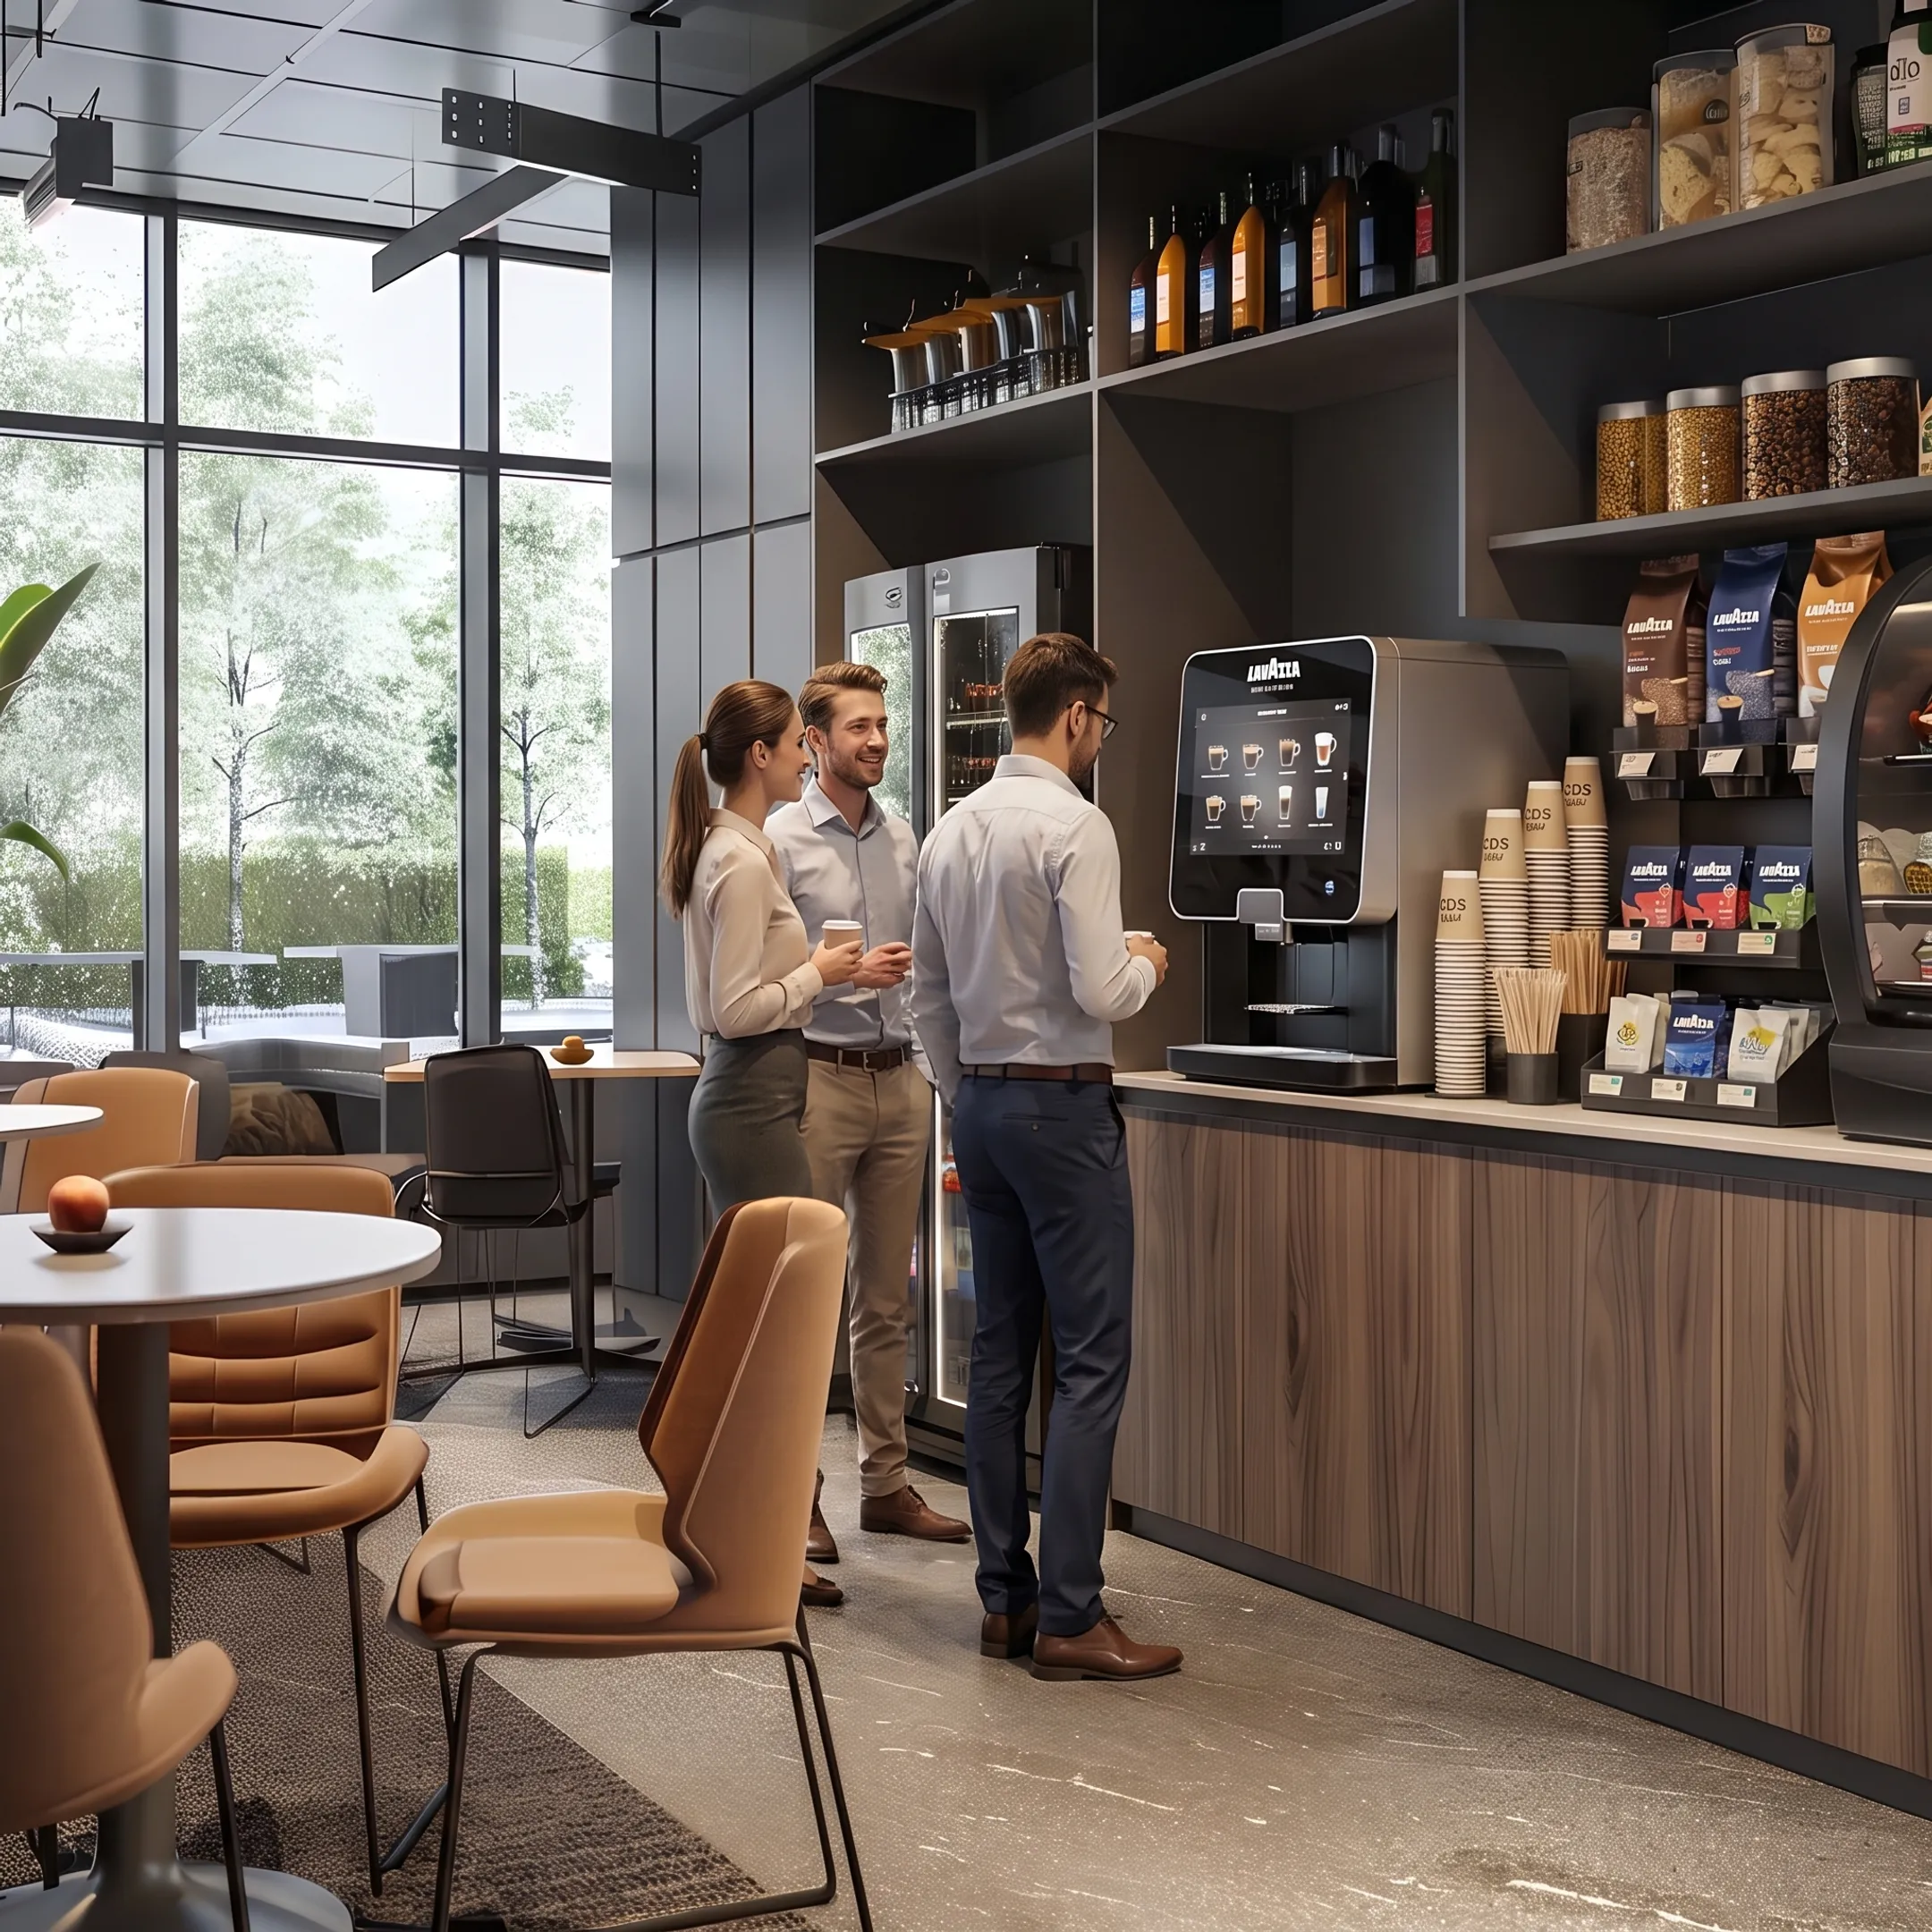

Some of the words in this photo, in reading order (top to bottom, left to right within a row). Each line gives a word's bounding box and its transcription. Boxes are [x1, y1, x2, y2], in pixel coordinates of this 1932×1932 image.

[1564, 784, 1592, 796] CDS
[1525, 808, 1552, 820] CDS
[1483, 837, 1509, 851] CDS
[1440, 898, 1467, 911] CDS
